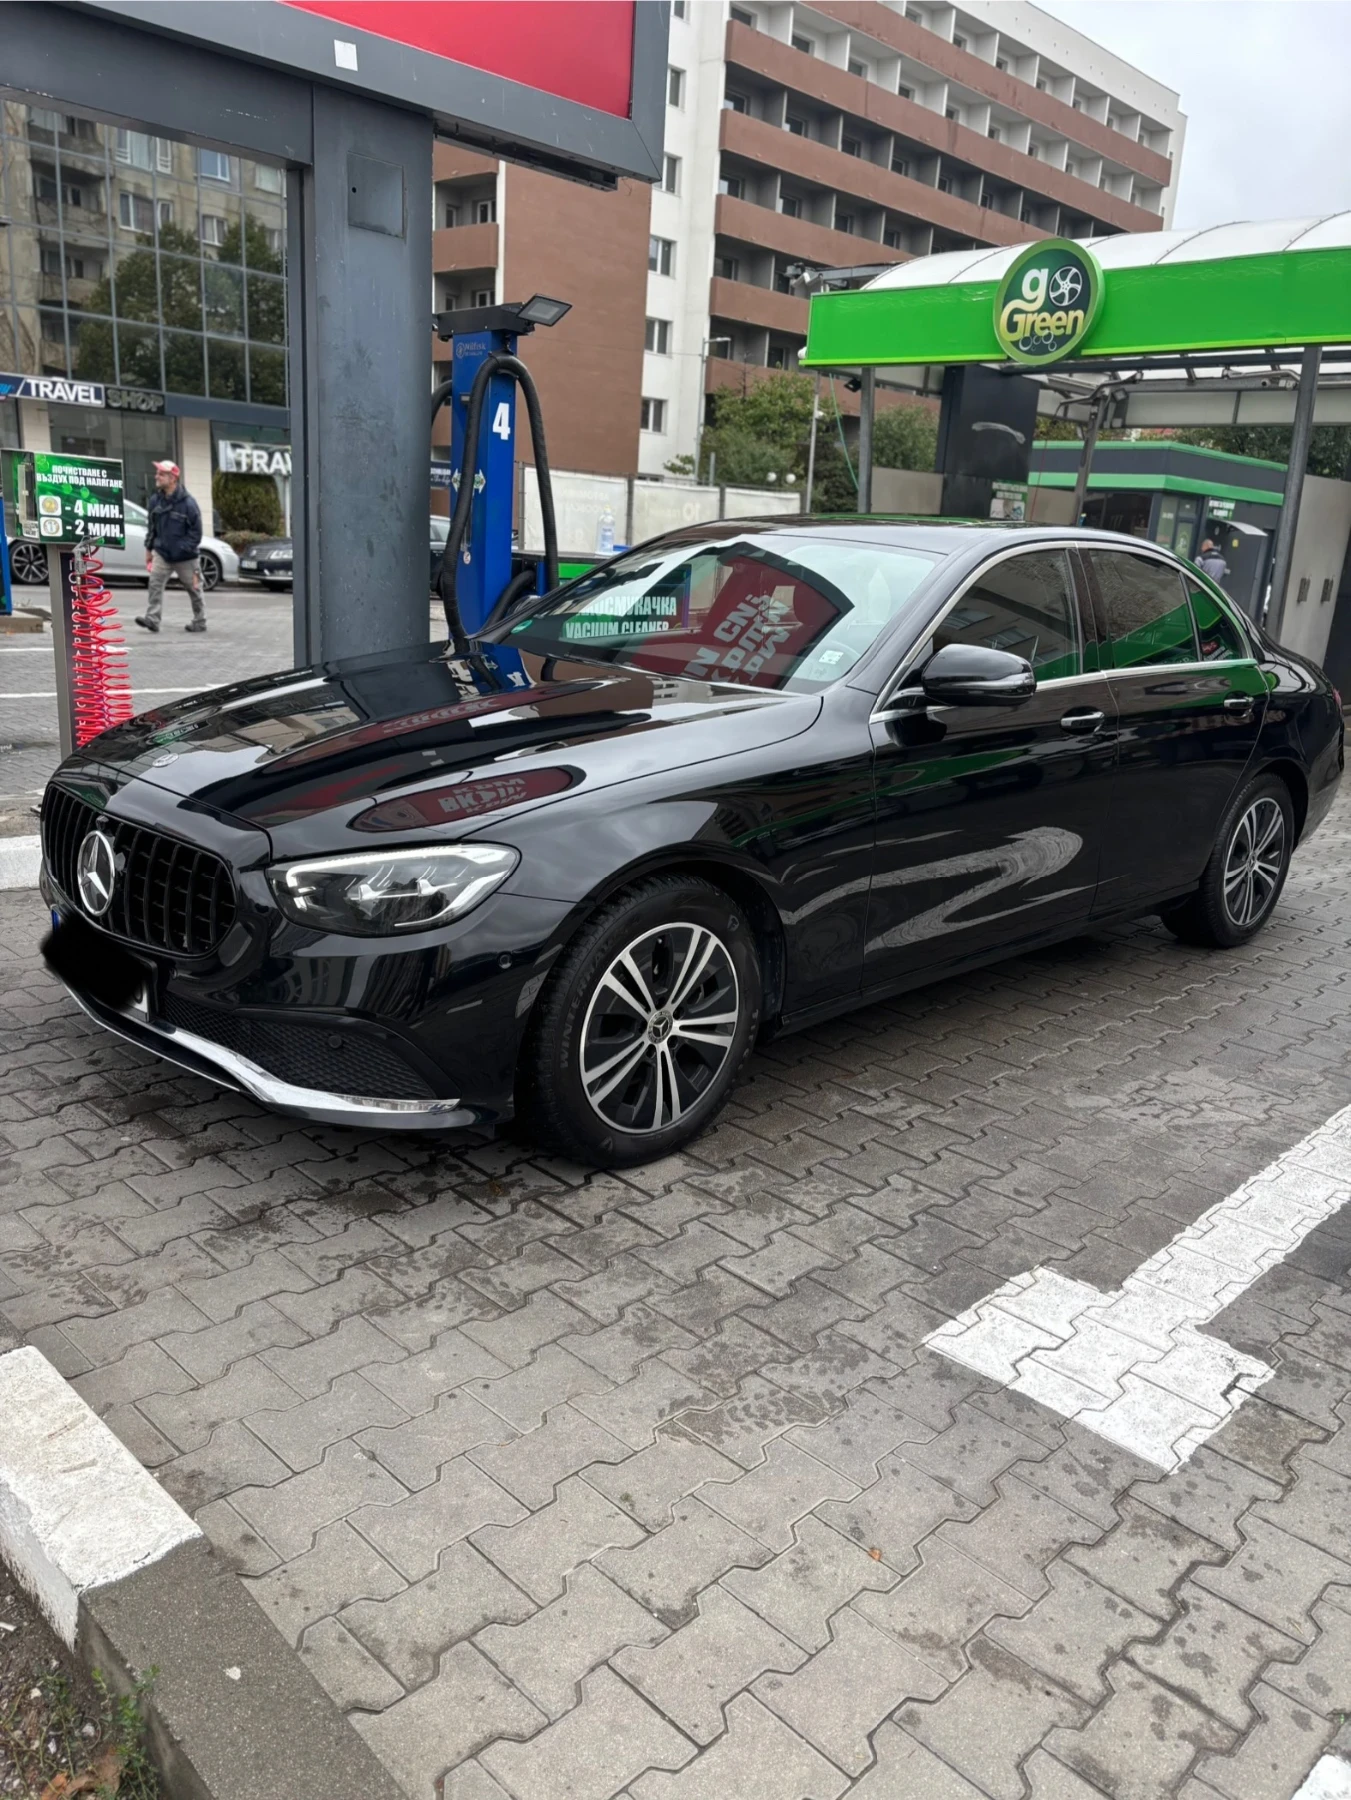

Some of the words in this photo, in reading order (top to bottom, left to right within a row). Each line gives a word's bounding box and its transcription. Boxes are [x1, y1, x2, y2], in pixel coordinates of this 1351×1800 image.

[999, 299, 1085, 342] Green
[25, 378, 102, 405] TRAVEL
[106, 389, 164, 412] SHOP
[492, 402, 511, 441] 4
[36, 473, 68, 484] ВЪЗДУХ
[69, 476, 86, 486] ПОД
[86, 478, 123, 488] НАЛЯГАНЕ
[52, 465, 101, 477] ПОЧИСТВАНЕ
[101, 469, 107, 478] С
[74, 499, 84, 517] 4
[87, 503, 123, 518] МИН.
[75, 519, 85, 535] 2
[87, 522, 123, 538] МИН.
[565, 620, 619, 639] VACUUM
